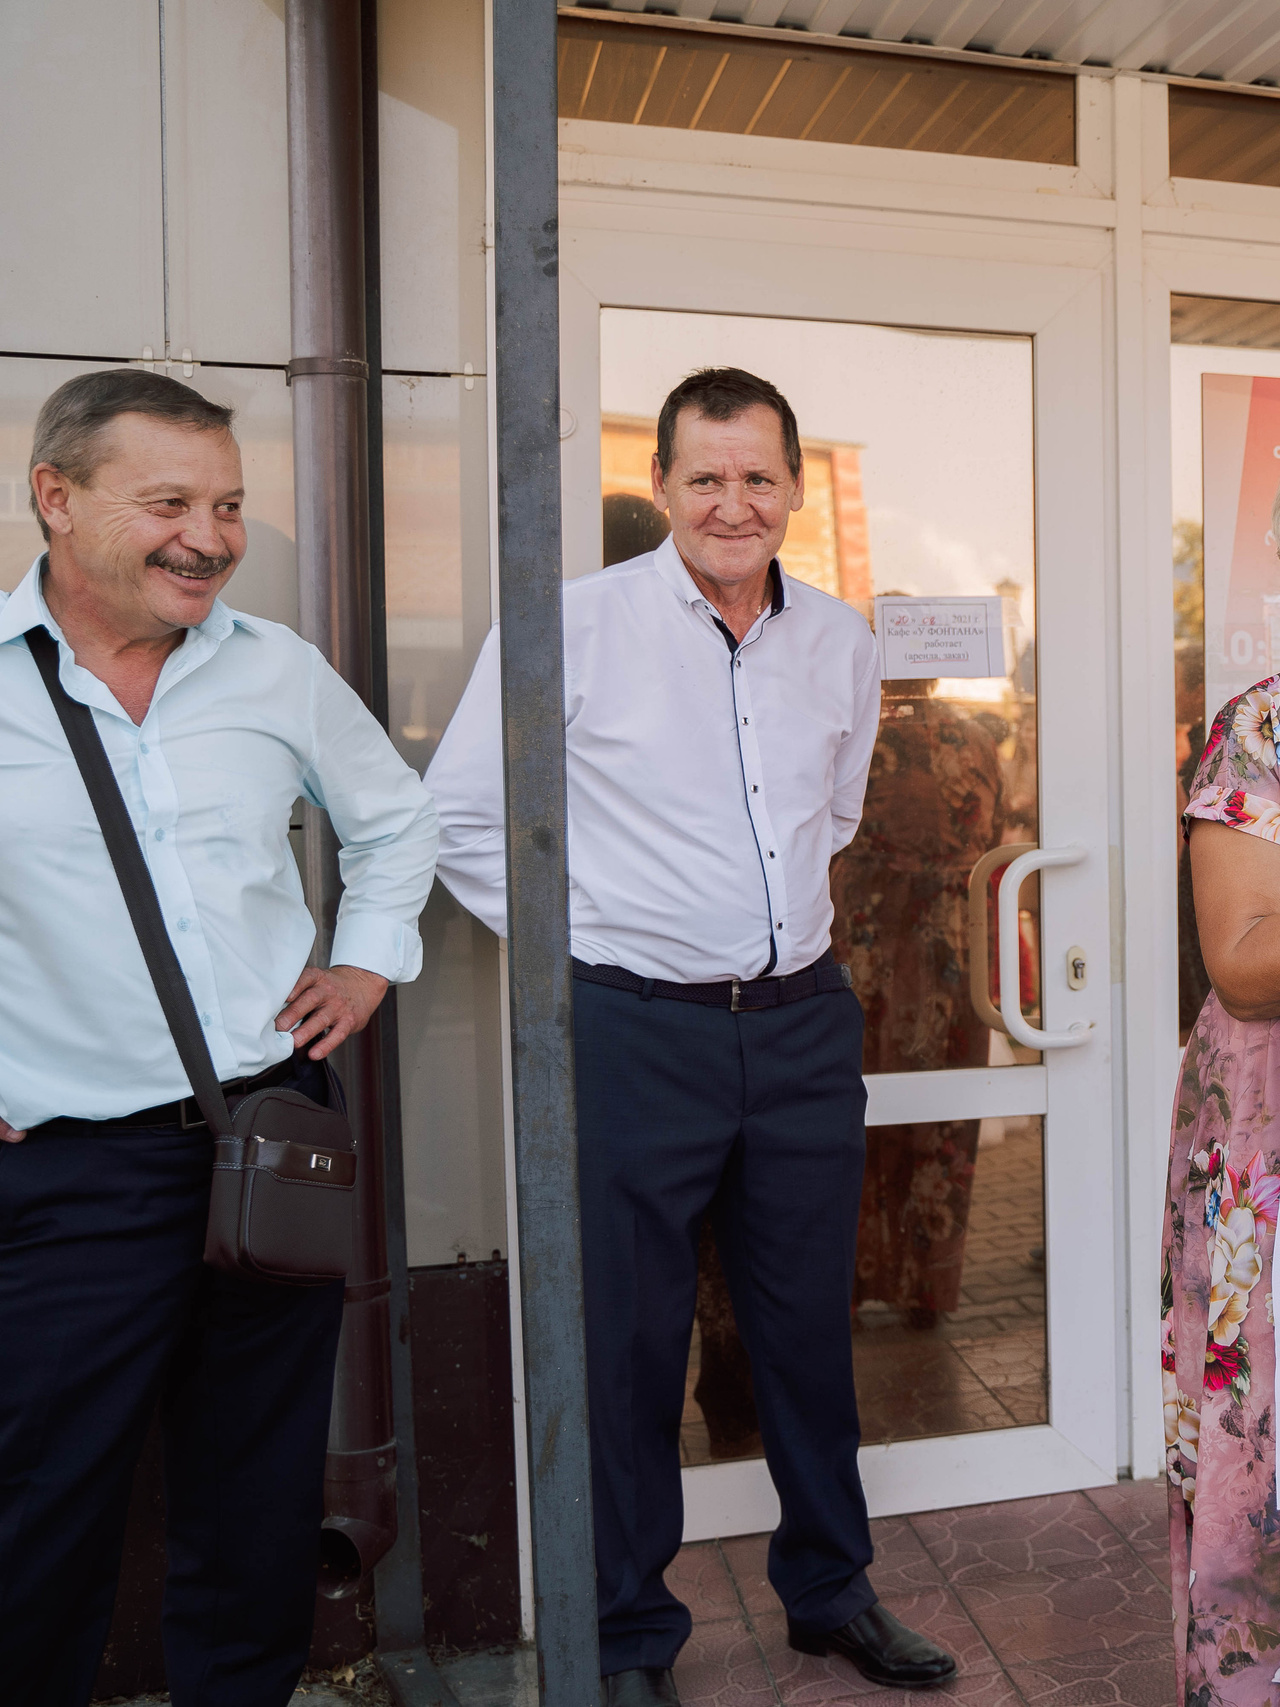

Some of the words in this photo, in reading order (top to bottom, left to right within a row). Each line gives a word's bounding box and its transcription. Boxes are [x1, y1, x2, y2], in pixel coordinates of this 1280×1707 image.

[952, 614, 972, 624] 2021
[887, 628, 911, 638] Кафе
[927, 627, 985, 636] ФОНТАНА»
[924, 639, 963, 650] работает
